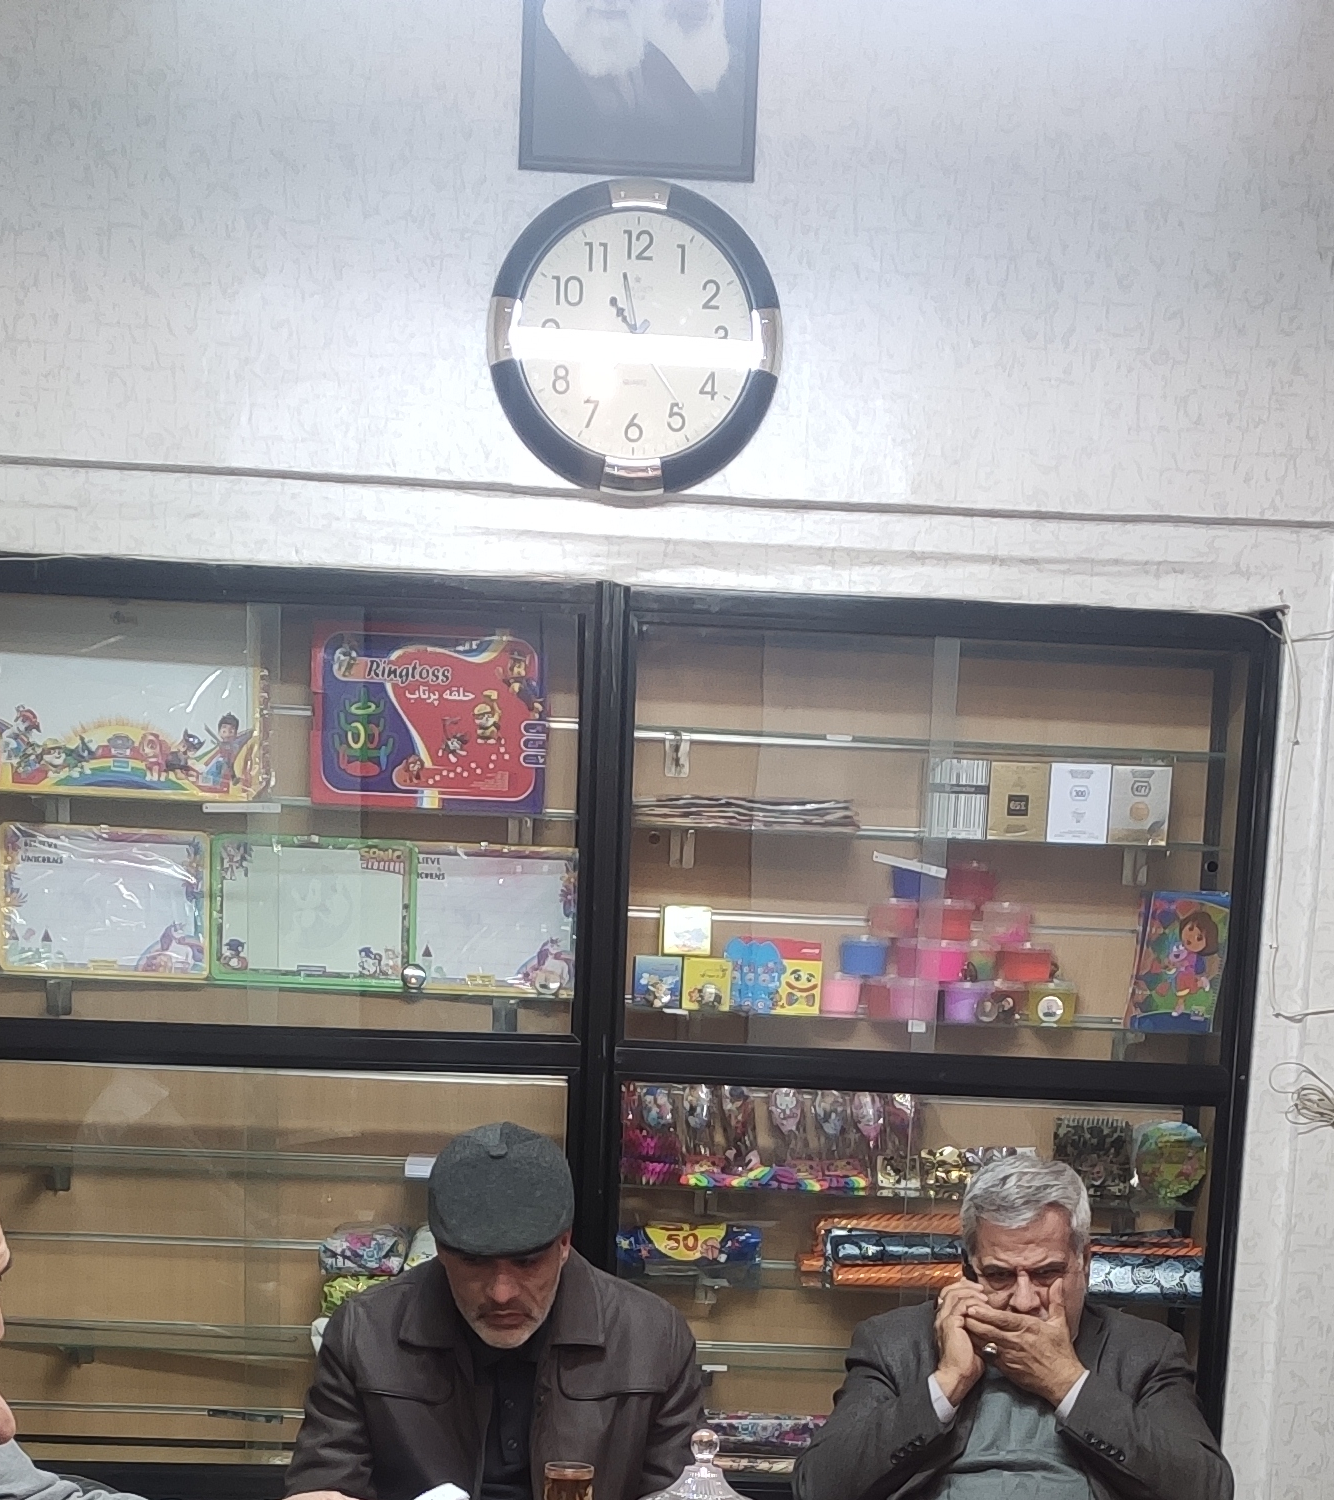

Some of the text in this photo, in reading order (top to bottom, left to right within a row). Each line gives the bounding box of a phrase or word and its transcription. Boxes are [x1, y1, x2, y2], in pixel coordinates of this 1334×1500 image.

[583, 241, 608, 272] 11
[622, 229, 654, 261] 12
[676, 243, 686, 274] 1
[551, 275, 584, 306] 10
[701, 279, 721, 310] 2
[551, 364, 570, 395] 8
[698, 371, 717, 401] 4
[583, 399, 599, 429] 7
[623, 413, 643, 442] 6
[666, 402, 686, 432] 5
[366, 659, 452, 685] Ringtoss
[405, 685, 476, 706] حلقه پرتاب
[359, 847, 405, 862] SONIC
[665, 1232, 699, 1252] 50
